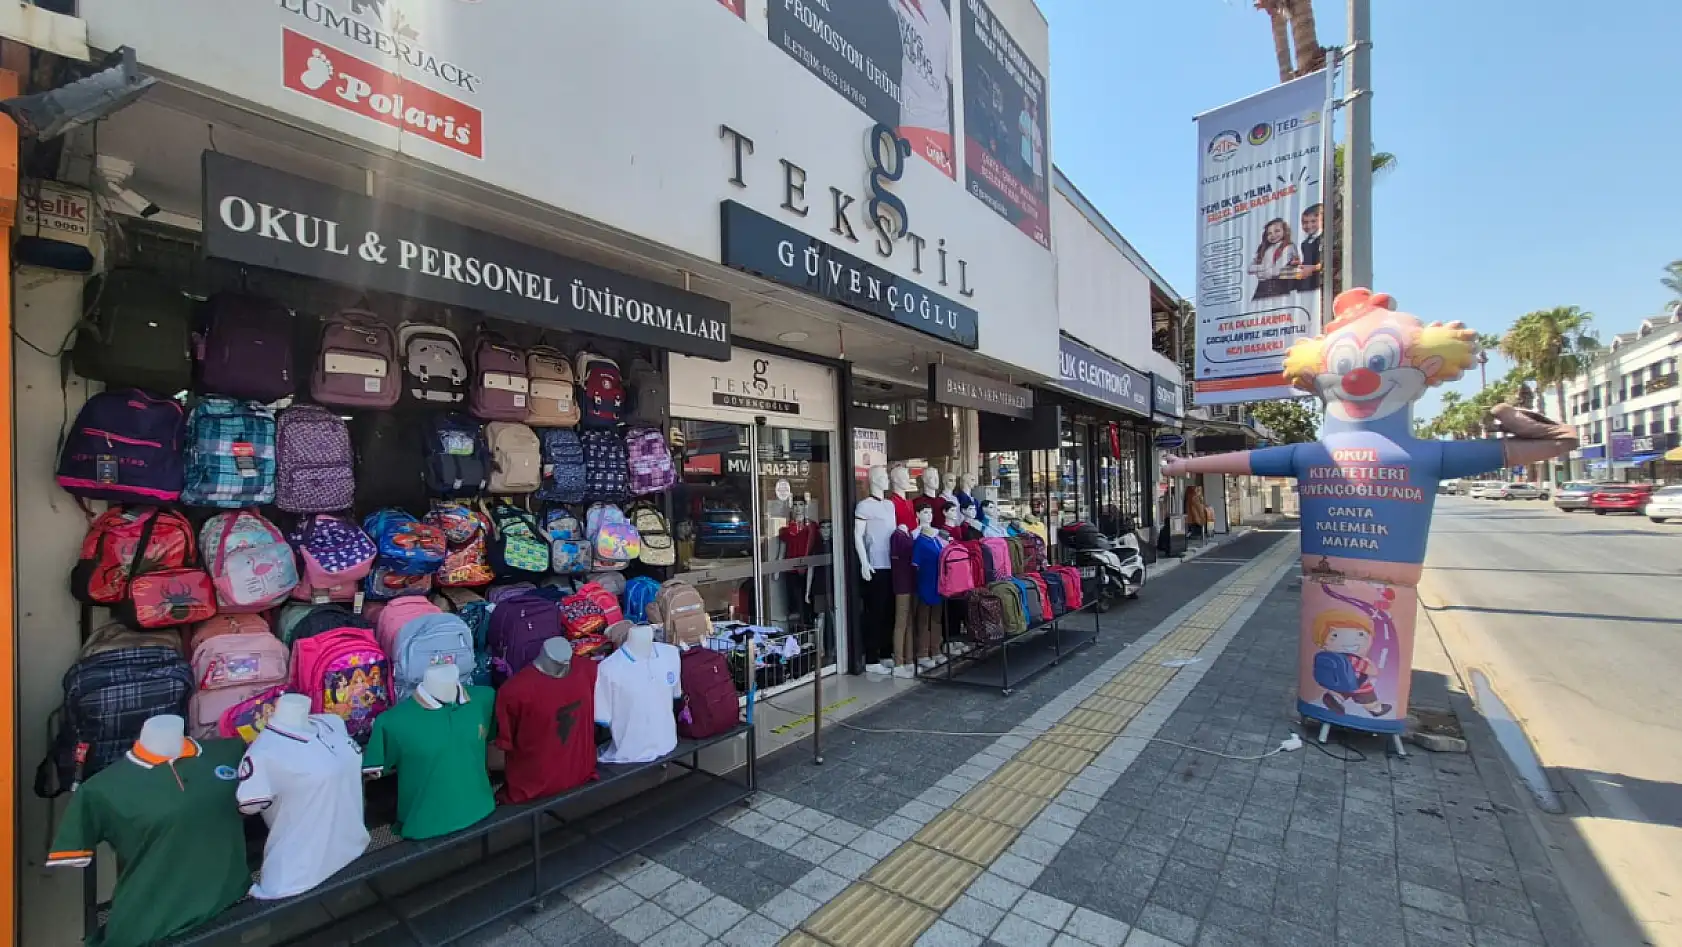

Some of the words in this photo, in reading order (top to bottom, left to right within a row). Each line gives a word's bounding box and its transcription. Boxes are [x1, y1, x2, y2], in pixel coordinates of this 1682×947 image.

[280, 0, 476, 93] LUMBERJACK
[784, 0, 863, 72] PROMOSYON
[335, 72, 471, 145] Polaris
[1276, 118, 1298, 132] TED
[719, 124, 974, 298] TEKSTİL
[219, 195, 349, 255] OKUL
[358, 231, 388, 264] &
[397, 239, 559, 304] PERSONEL
[569, 278, 727, 343] ÜNİFORMALARI
[777, 240, 958, 331] GÜVENÇOĞLU
[1333, 450, 1377, 462] OKUL
[1322, 535, 1379, 550] MATARA
